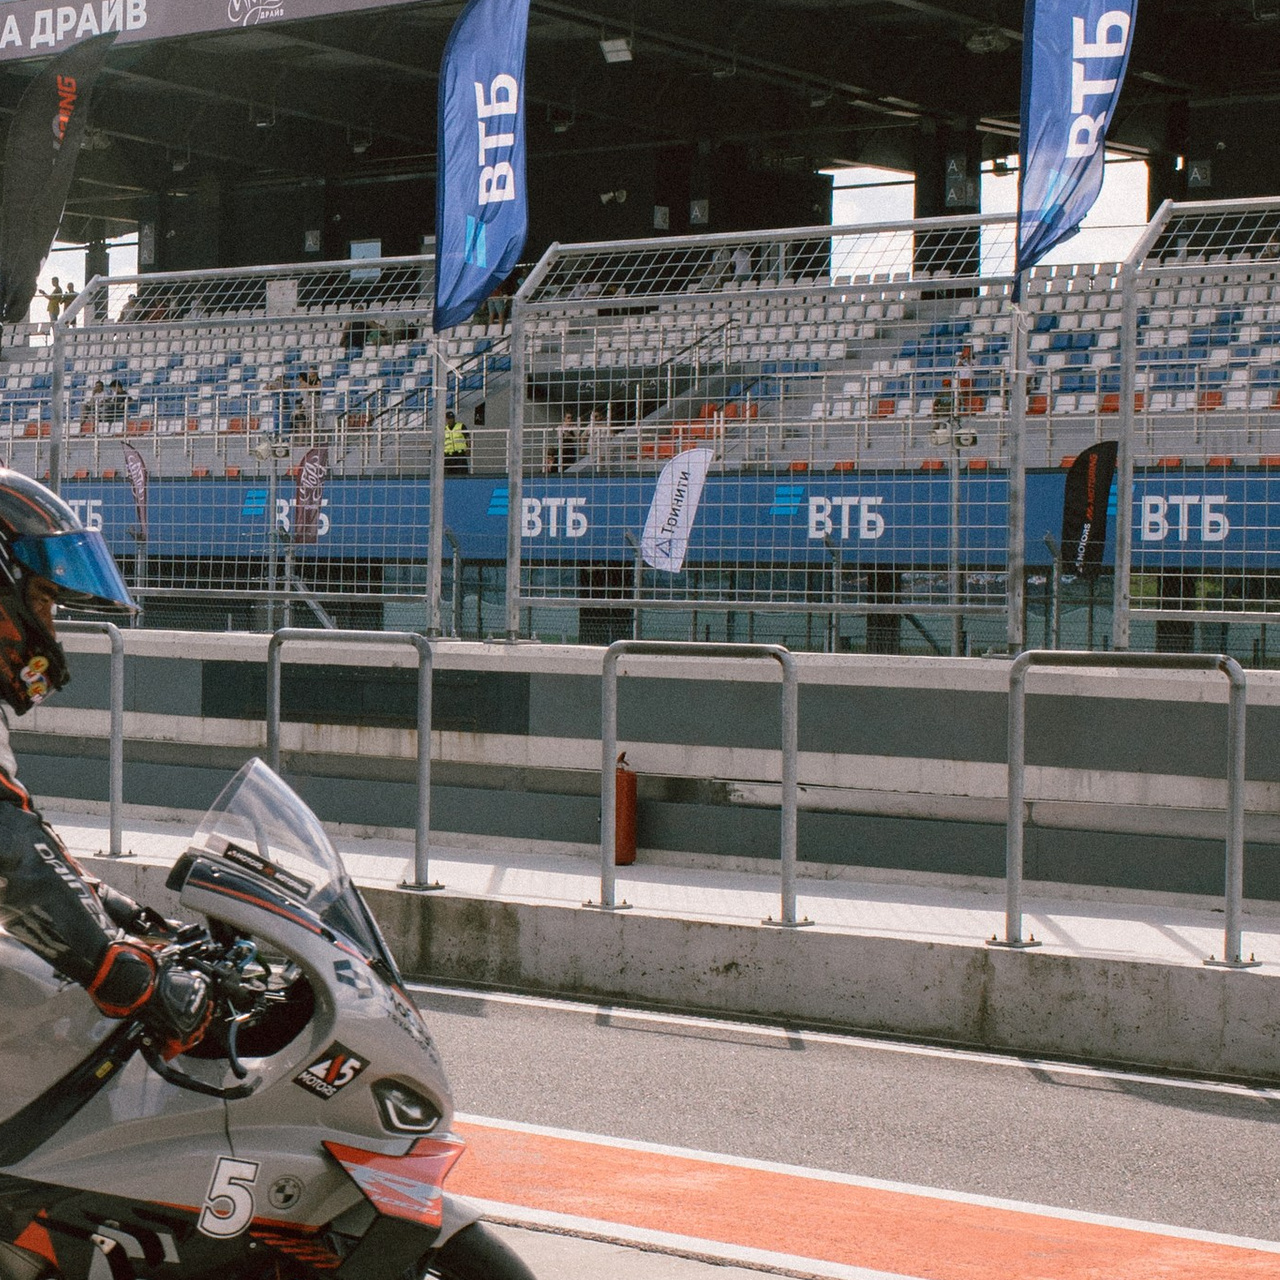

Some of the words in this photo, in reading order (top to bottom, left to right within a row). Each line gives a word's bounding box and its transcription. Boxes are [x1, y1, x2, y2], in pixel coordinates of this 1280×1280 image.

[474, 73, 519, 206] ВТБ
[68, 499, 103, 533] ТБ
[276, 498, 330, 536] ВБ
[521, 497, 588, 538] ВТБ
[808, 496, 885, 540] ВТБ
[1141, 494, 1229, 541] ВТБ
[298, 1070, 338, 1097] MOTORS
[197, 1154, 261, 1239] 5
